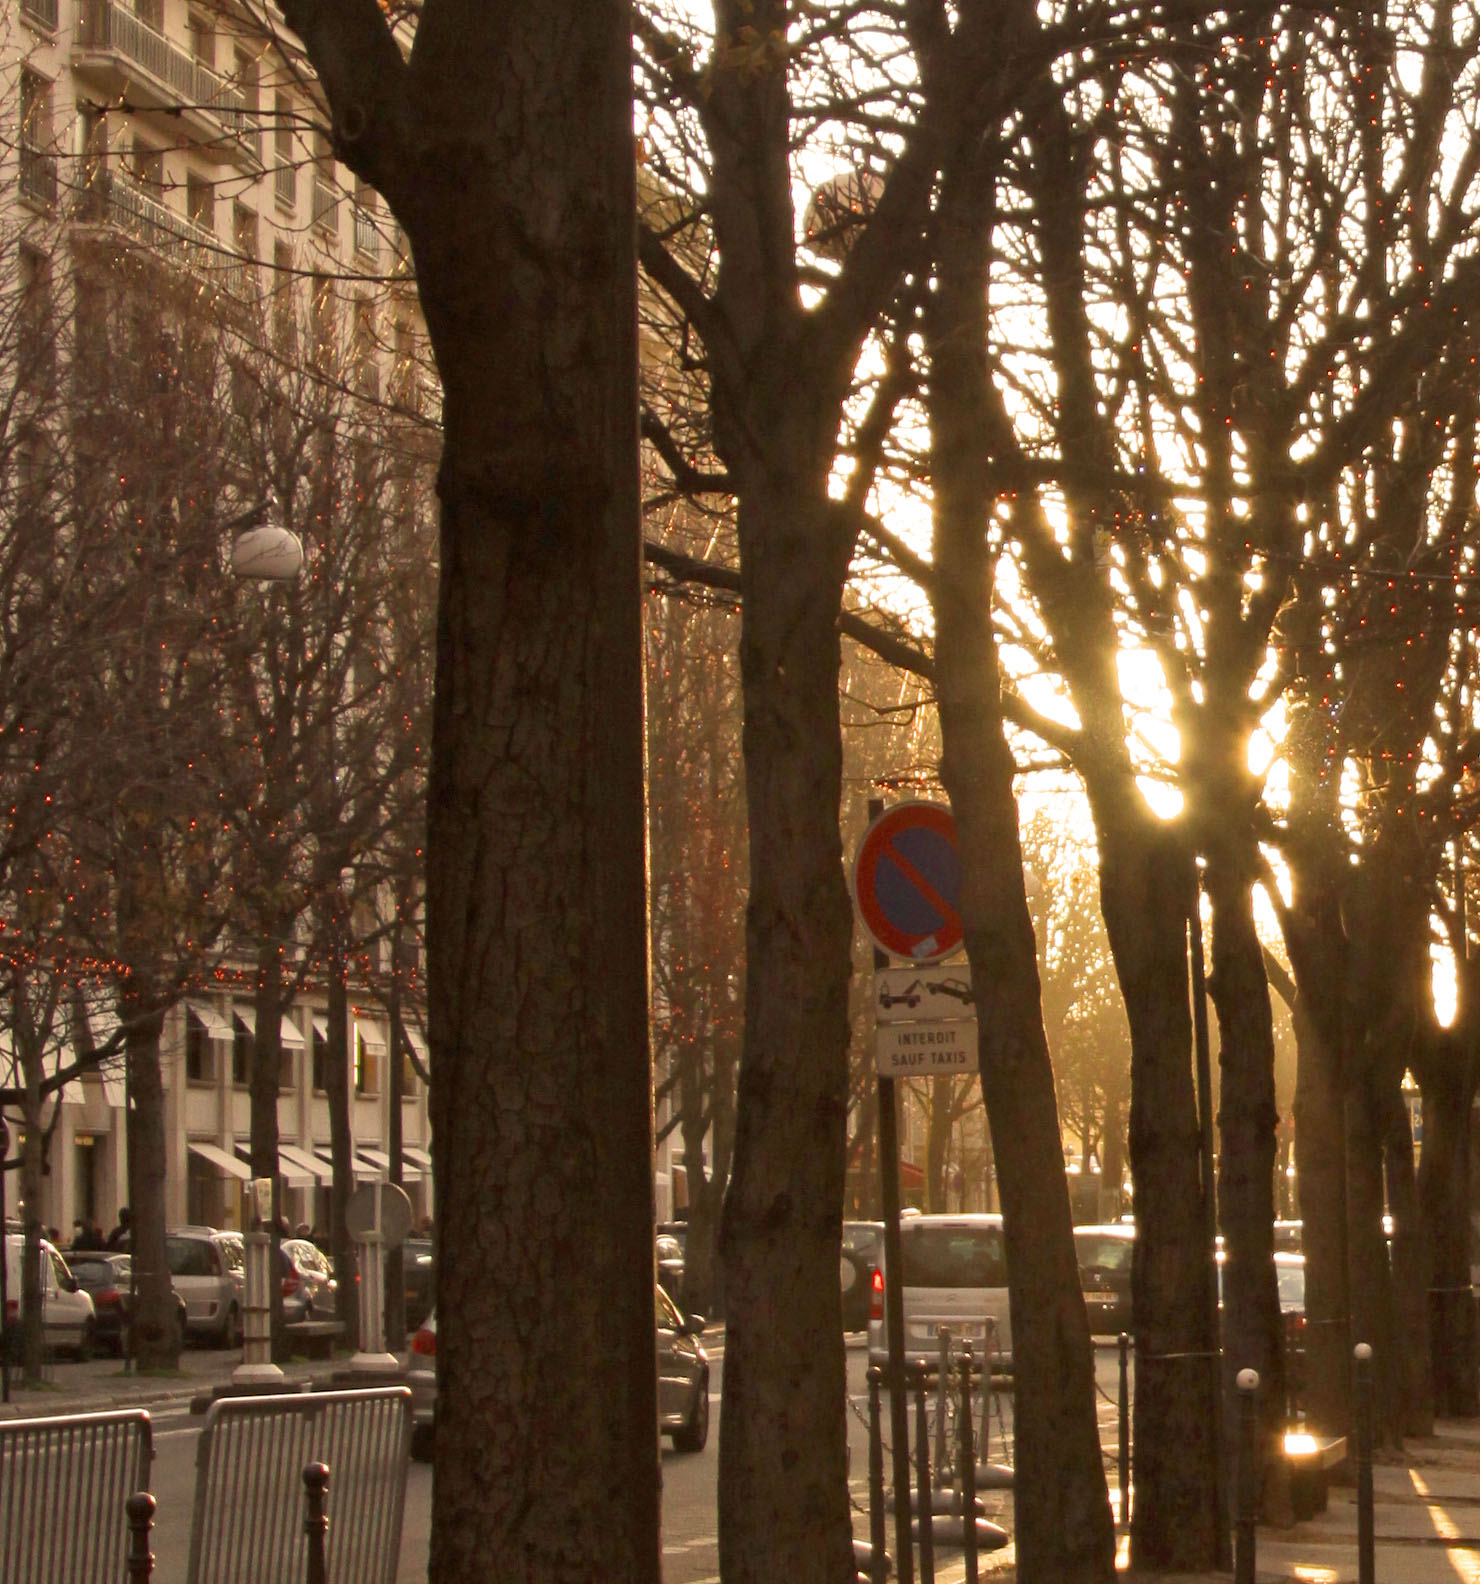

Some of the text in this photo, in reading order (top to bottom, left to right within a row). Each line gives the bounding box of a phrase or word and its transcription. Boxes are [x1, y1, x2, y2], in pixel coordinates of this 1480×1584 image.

[898, 1031, 956, 1045] INTERDIT
[891, 1051, 966, 1066] SAUF TAXIS
